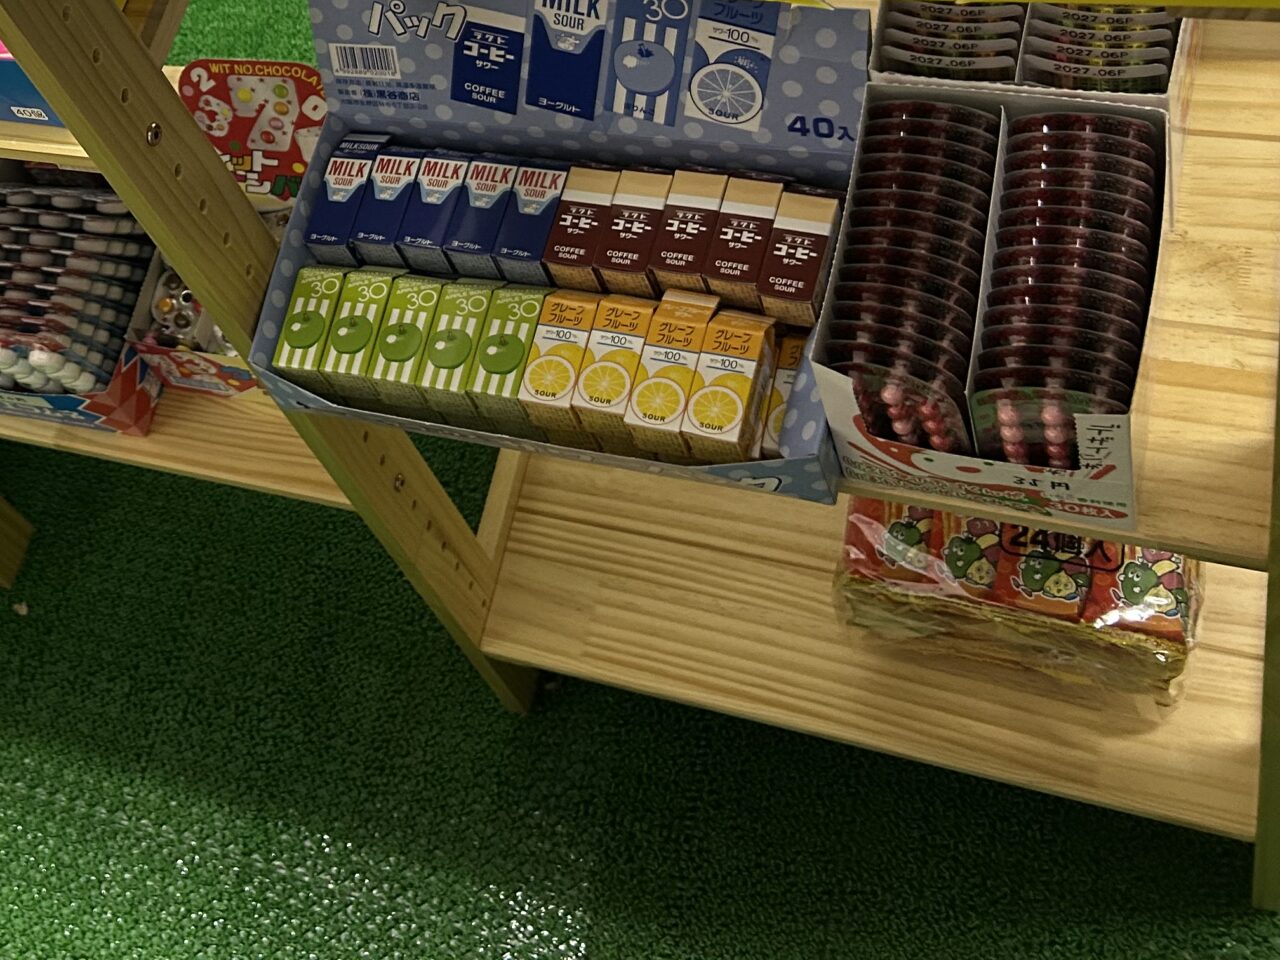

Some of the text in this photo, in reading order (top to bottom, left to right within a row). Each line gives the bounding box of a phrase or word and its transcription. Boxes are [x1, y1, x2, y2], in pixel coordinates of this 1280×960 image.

[368, 0, 467, 41] パック
[553, 13, 585, 31] SOUR
[787, 115, 856, 142] 40入
[329, 160, 364, 178] MILK
[375, 158, 416, 177] MILK
[422, 160, 463, 180] MILK
[470, 164, 510, 185] MILK
[333, 177, 353, 187] SOUR
[380, 175, 401, 185] SOUR
[520, 169, 559, 190] MILK
[475, 182, 497, 193] SOUR
[524, 188, 546, 200] SOUR
[559, 215, 599, 229] コーヒー
[611, 219, 652, 233] コーヒー
[720, 227, 762, 243] コーヒー
[554, 245, 586, 256] COFFEE
[606, 250, 639, 261] COFFEE
[773, 243, 818, 260] コーヒー
[715, 260, 749, 271] COFFEE
[310, 278, 339, 298] 30
[769, 276, 804, 289] COFFEE
[358, 282, 387, 303] 30
[456, 295, 487, 316] 30
[508, 300, 539, 321] 30
[550, 313, 583, 326] フルーツ
[604, 318, 638, 331] フルーツ
[657, 334, 693, 347] フルーツ
[713, 341, 749, 354] フルーツ
[642, 412, 666, 422] SOUR
[699, 422, 723, 432] SOUR
